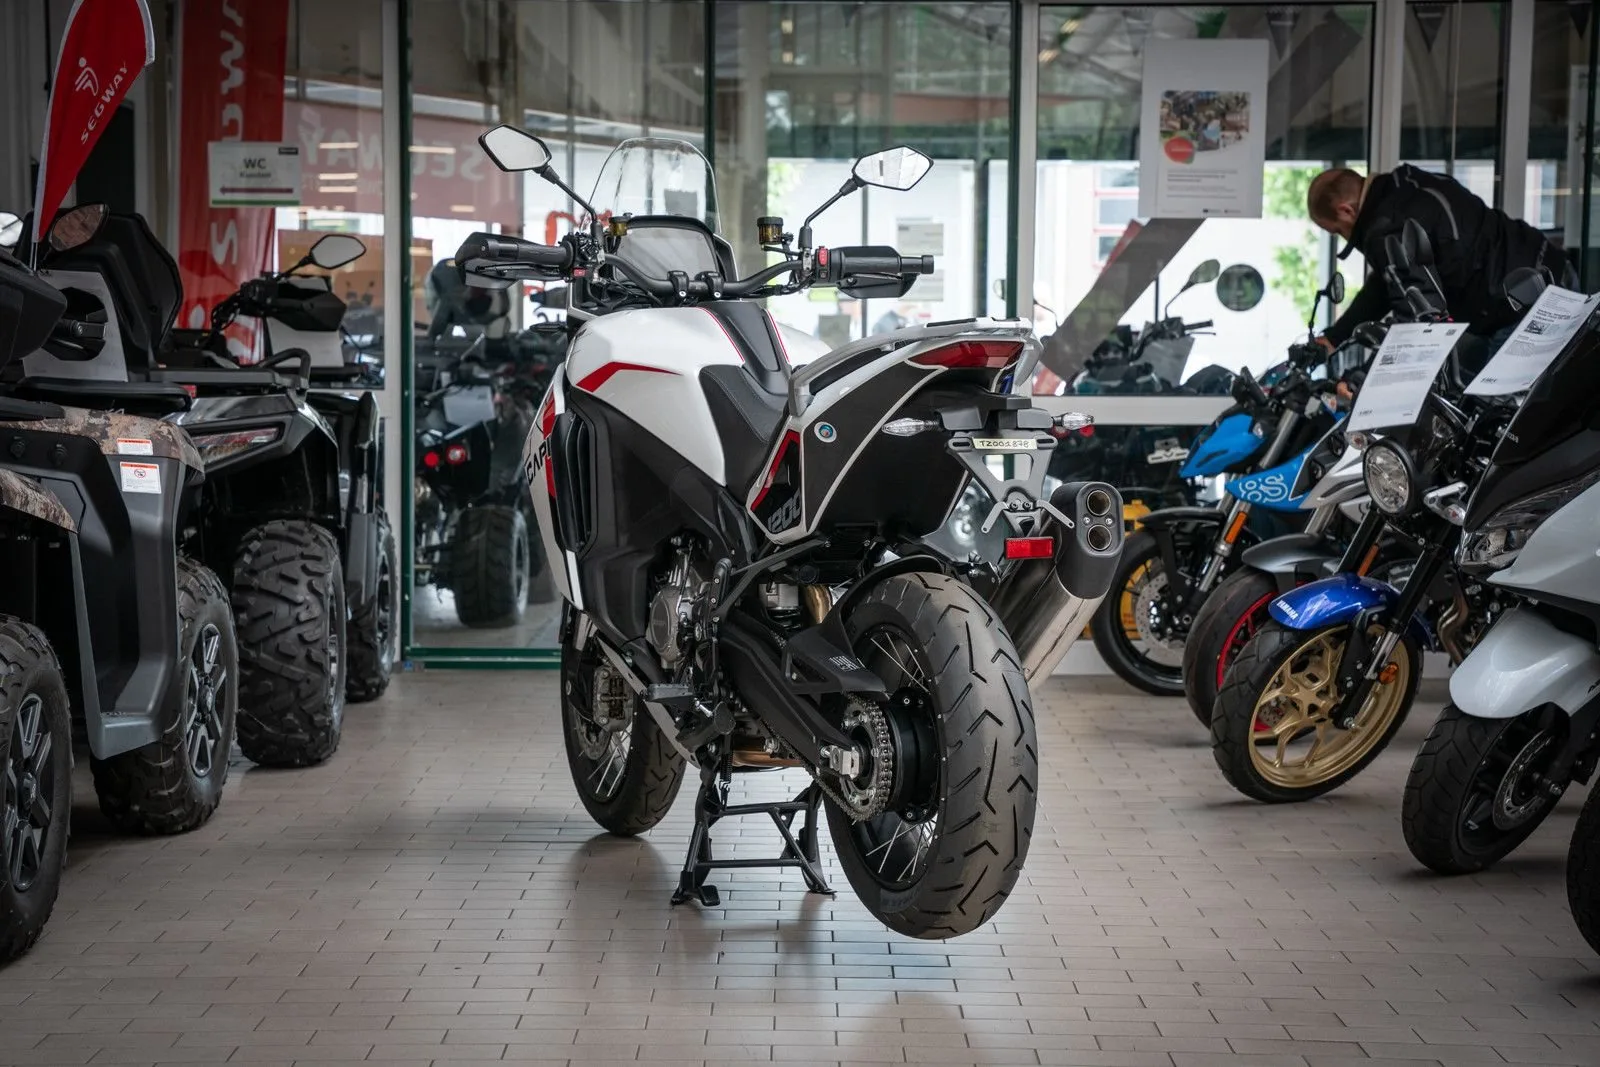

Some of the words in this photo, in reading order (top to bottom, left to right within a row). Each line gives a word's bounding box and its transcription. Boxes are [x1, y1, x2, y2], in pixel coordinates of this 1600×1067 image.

[81, 61, 127, 145] SEGWAY
[243, 158, 267, 170] WC
[526, 438, 551, 486] CAP
[767, 487, 802, 533] 1200
